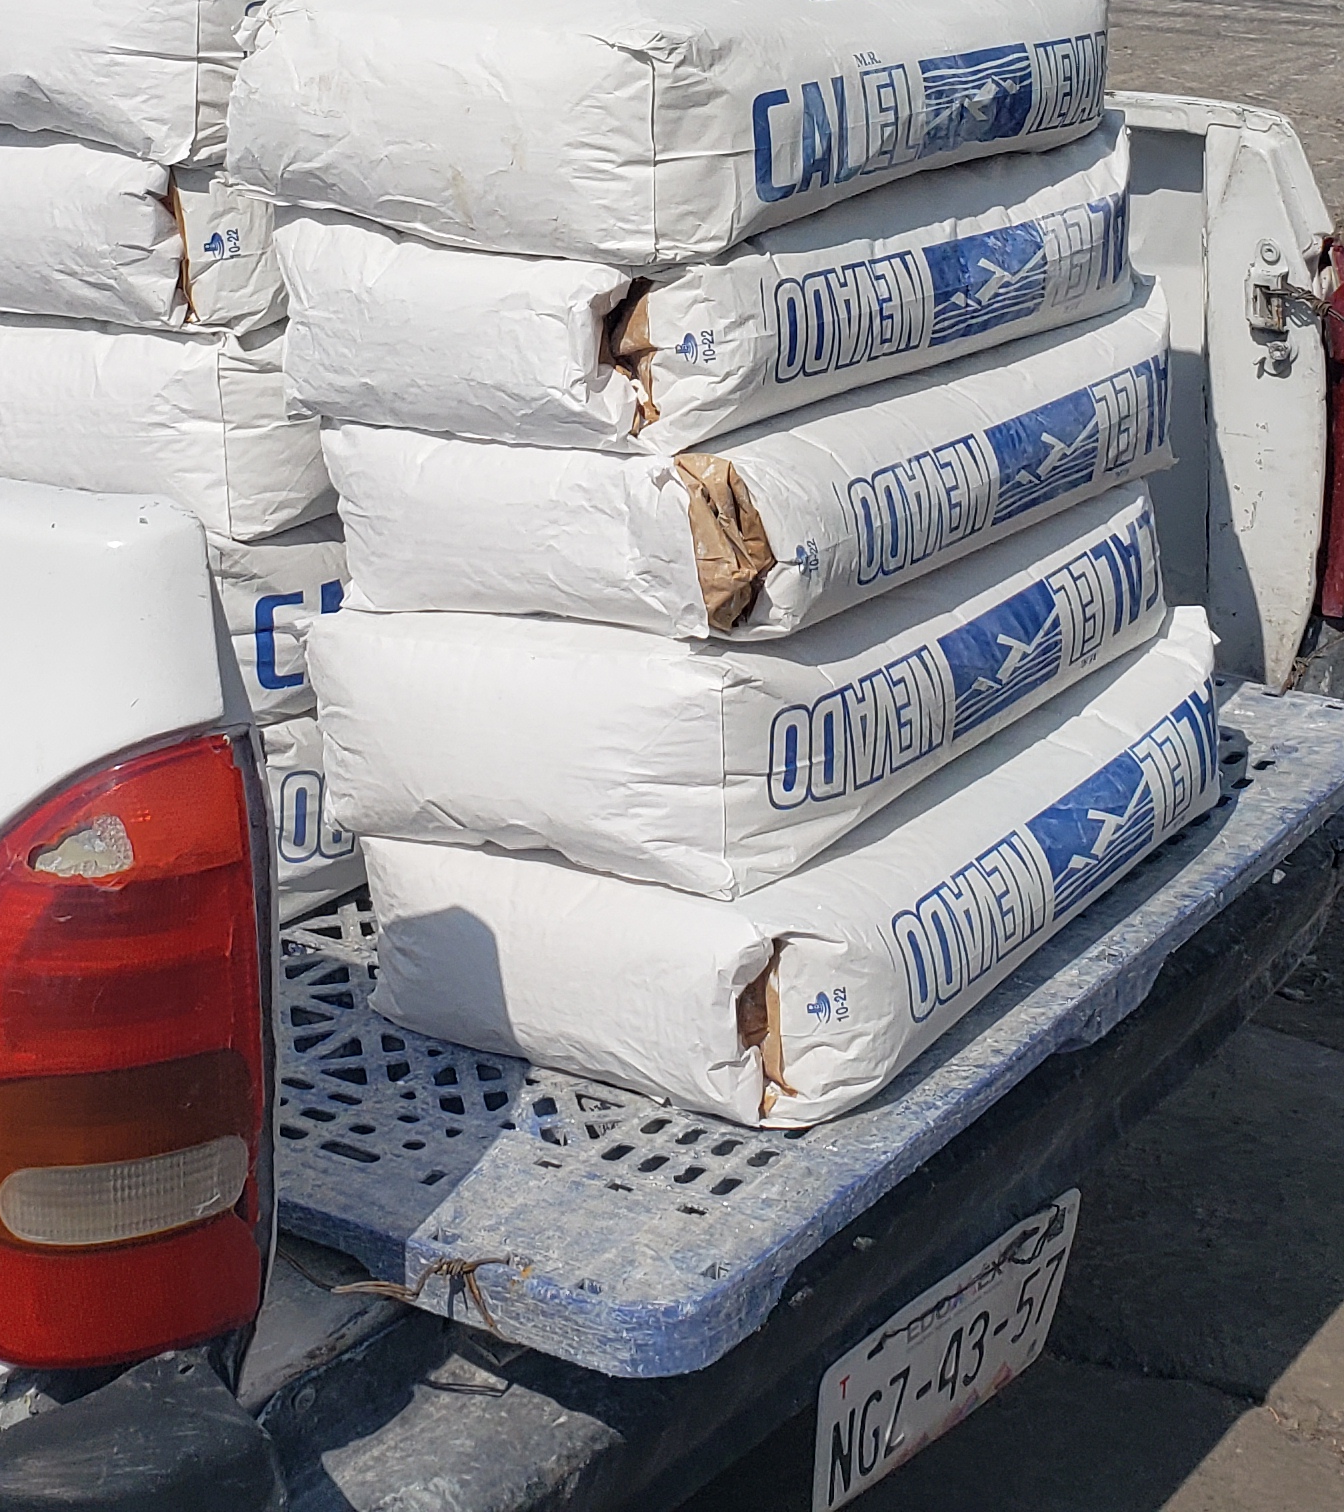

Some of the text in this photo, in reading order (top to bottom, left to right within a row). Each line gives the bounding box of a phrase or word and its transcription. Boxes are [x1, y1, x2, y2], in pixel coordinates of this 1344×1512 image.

[227, 228, 241, 259] 10-22
[700, 329, 717, 364] 10-22
[774, 250, 932, 384] NEVADO
[847, 433, 995, 586] NEVADO
[767, 640, 950, 811] NEVADO
[891, 828, 1050, 1024] NEVADO
[832, 986, 850, 1023] 10-22
[827, 1245, 1067, 1508] NGZ-43-57
